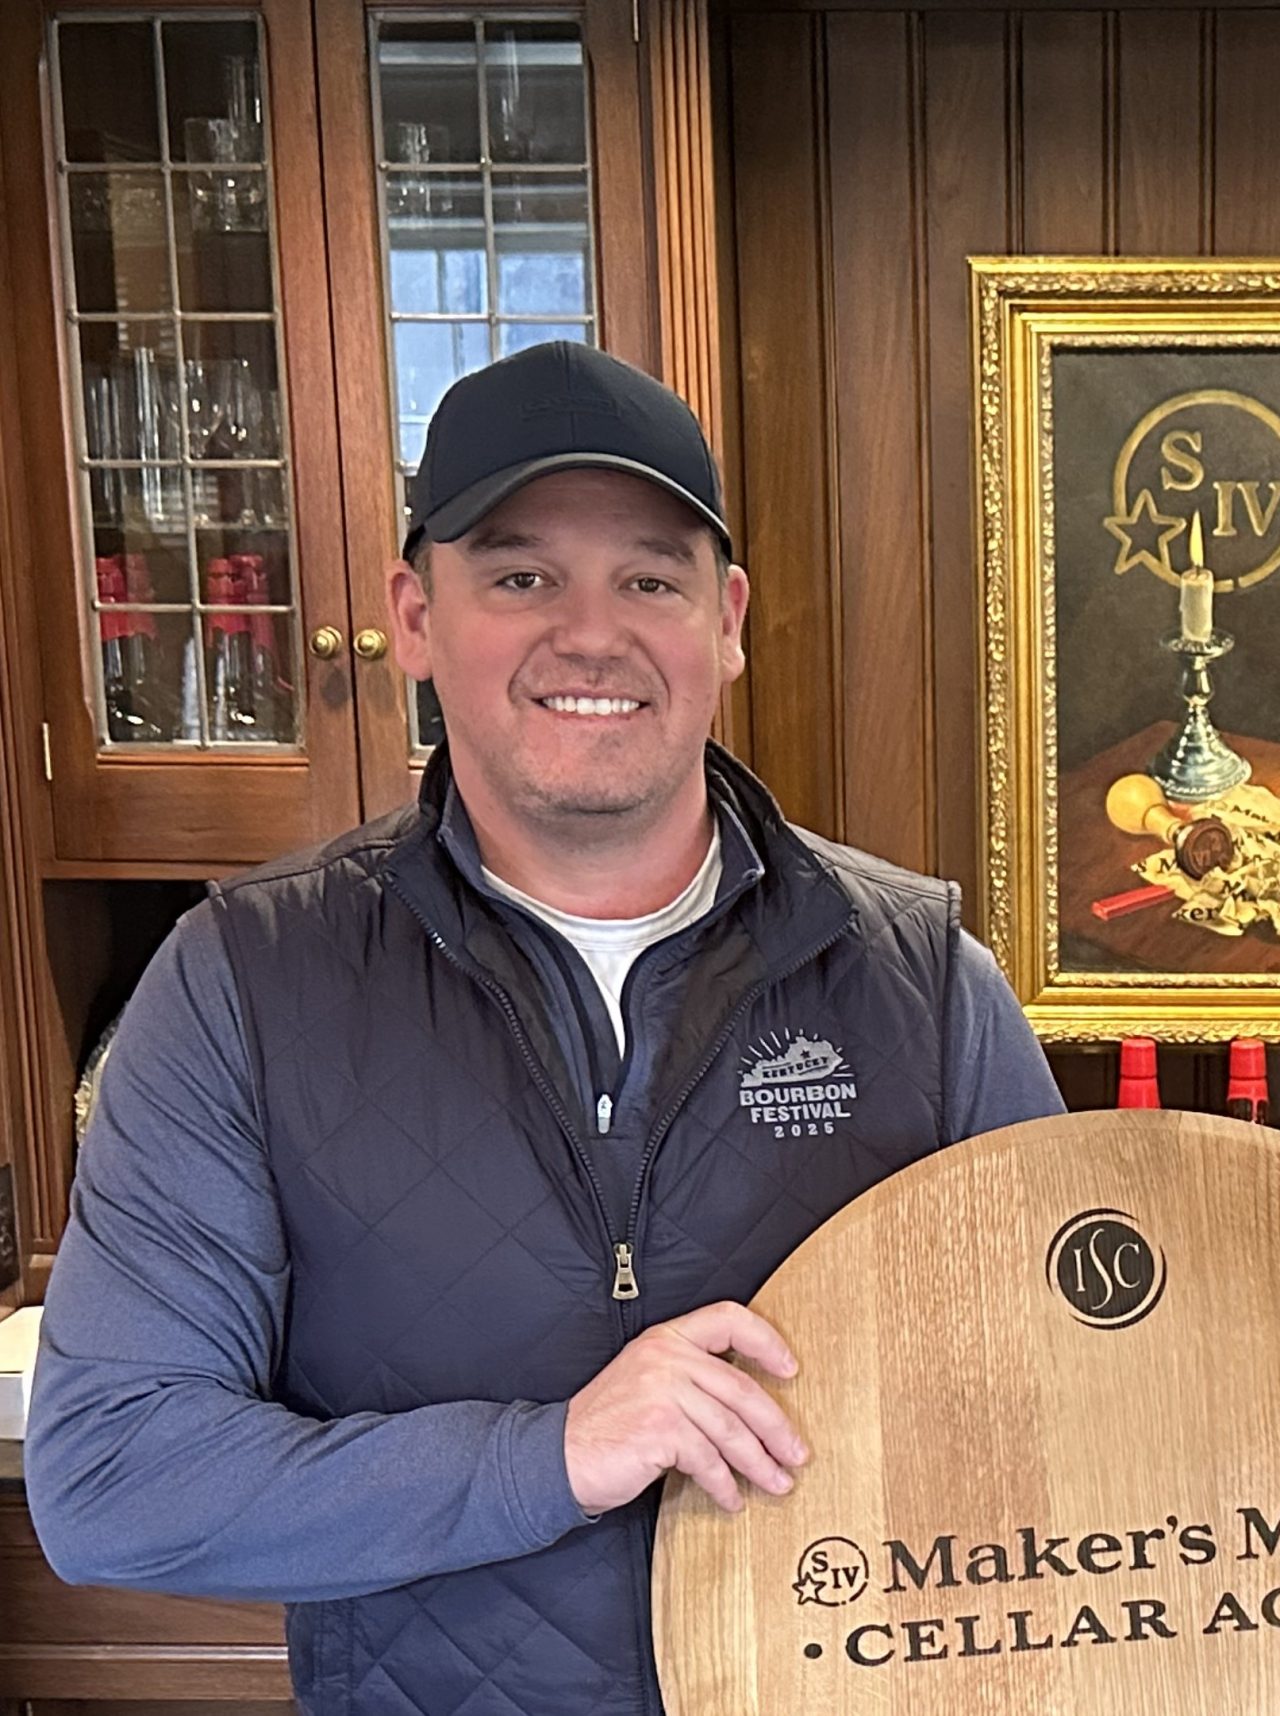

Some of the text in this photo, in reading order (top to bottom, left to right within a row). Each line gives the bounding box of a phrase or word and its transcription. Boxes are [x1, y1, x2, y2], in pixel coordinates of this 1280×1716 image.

[1160, 431, 1204, 491] S
[762, 1056, 829, 1079] KENTUCKY
[739, 1083, 857, 1106] BOURBON
[751, 1102, 851, 1123] FESTIVAL
[774, 1122, 834, 1138] 2025
[1073, 1227, 1141, 1310] ISC
[811, 1551, 829, 1574] S
[883, 1515, 1218, 1595] Maker's
[830, 1565, 860, 1589] IV
[845, 1599, 1177, 1668] CELLAR
